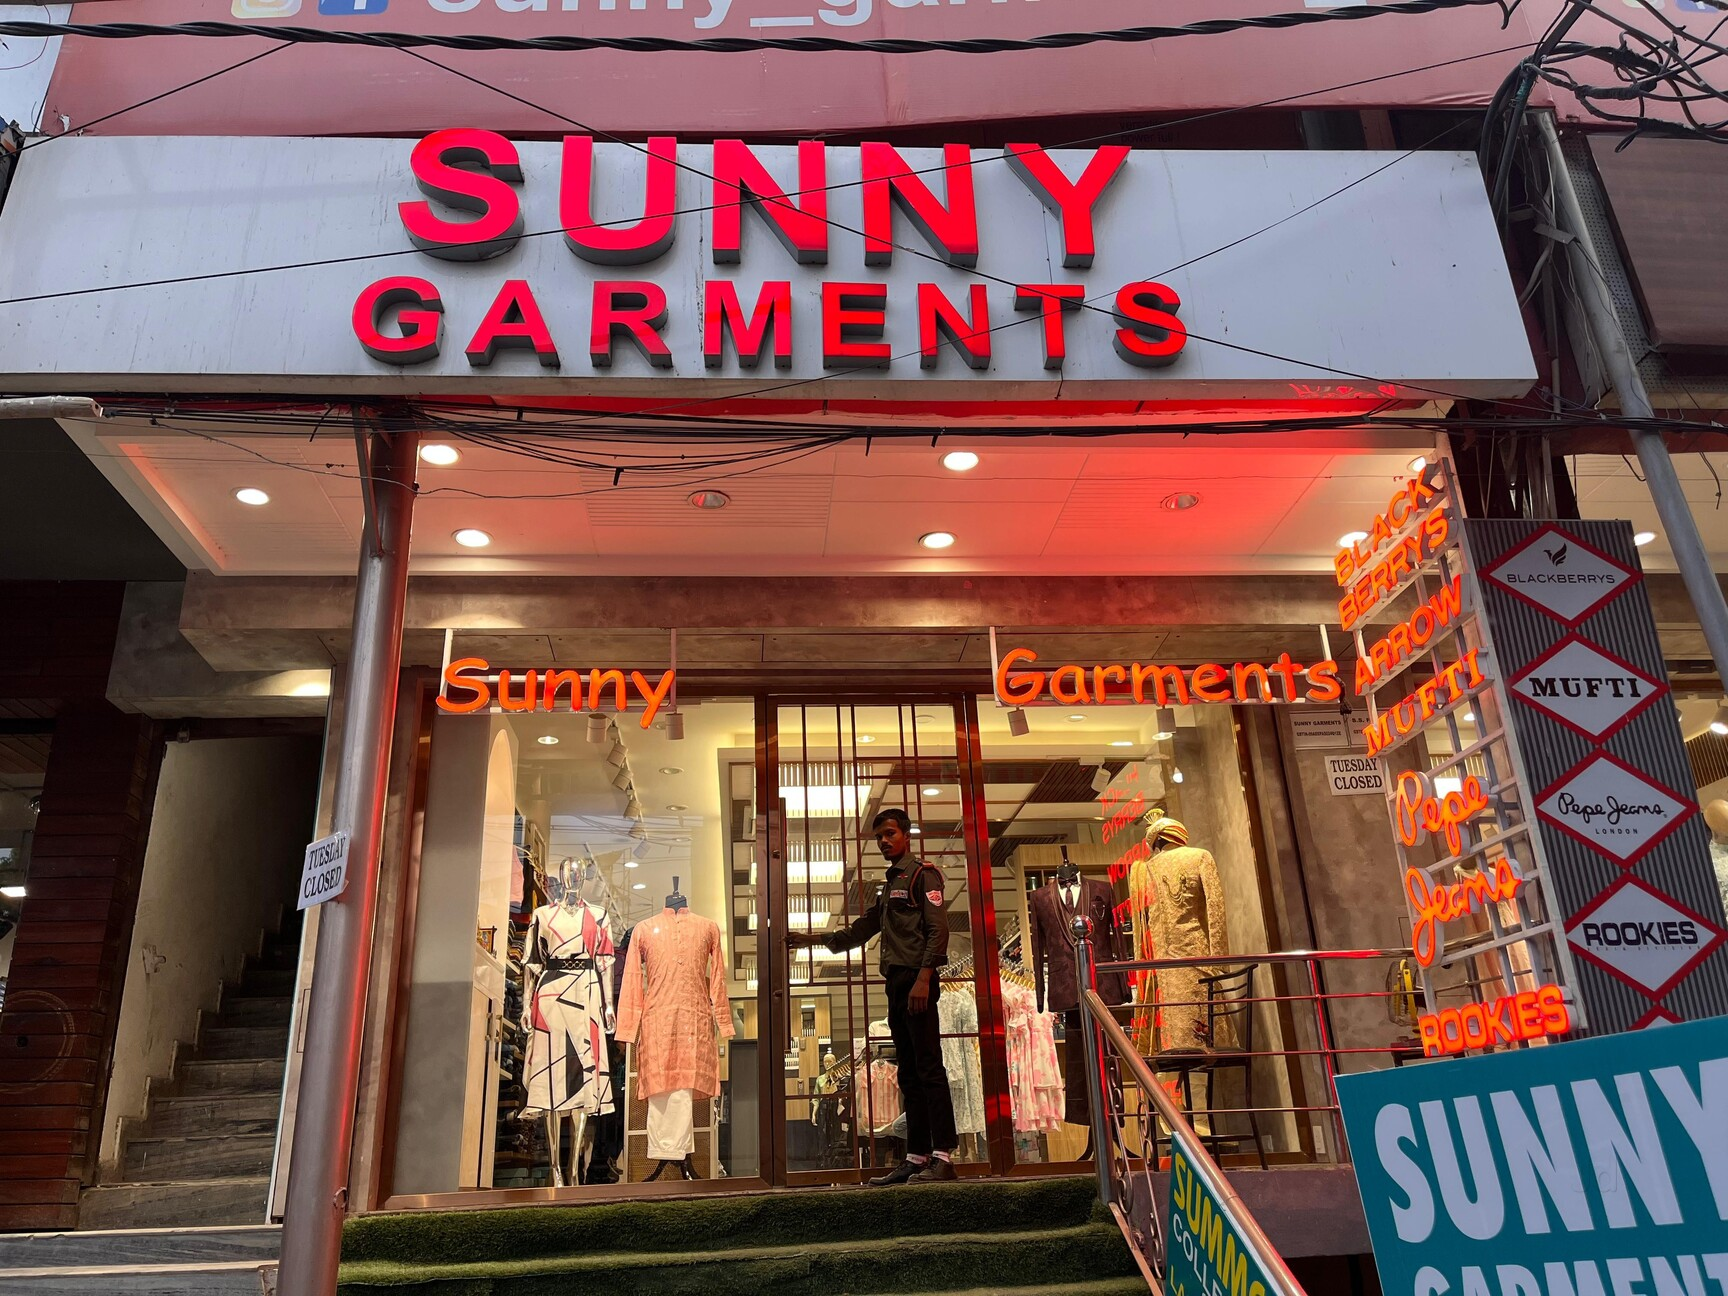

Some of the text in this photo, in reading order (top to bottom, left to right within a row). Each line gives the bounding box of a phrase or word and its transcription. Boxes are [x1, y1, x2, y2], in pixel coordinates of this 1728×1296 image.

[399, 127, 1131, 266] SUNNY
[352, 276, 1187, 370] GARMENTS
[1333, 466, 1436, 586] BLACK
[1337, 507, 1449, 631] BERRYS
[1507, 574, 1615, 584] BLACKBERRYS
[1355, 575, 1462, 695] ARROW
[436, 648, 1341, 728] Sunny Garments
[1362, 648, 1485, 758] MUFTI
[1529, 677, 1642, 698] MUFTI
[1330, 758, 1377, 773] TUESDAY
[1334, 775, 1383, 790] CLOSED
[1396, 769, 1489, 857] Pepe
[1558, 792, 1664, 825] Pepe Jeans
[304, 866, 342, 898] CLOSED
[308, 836, 346, 871] TUESDAY
[1405, 857, 1521, 967] Jeans
[1582, 921, 1698, 946] ROOKIES
[1418, 984, 1570, 1056] ROOKIES
[1374, 1058, 1728, 1243] SUNNY
